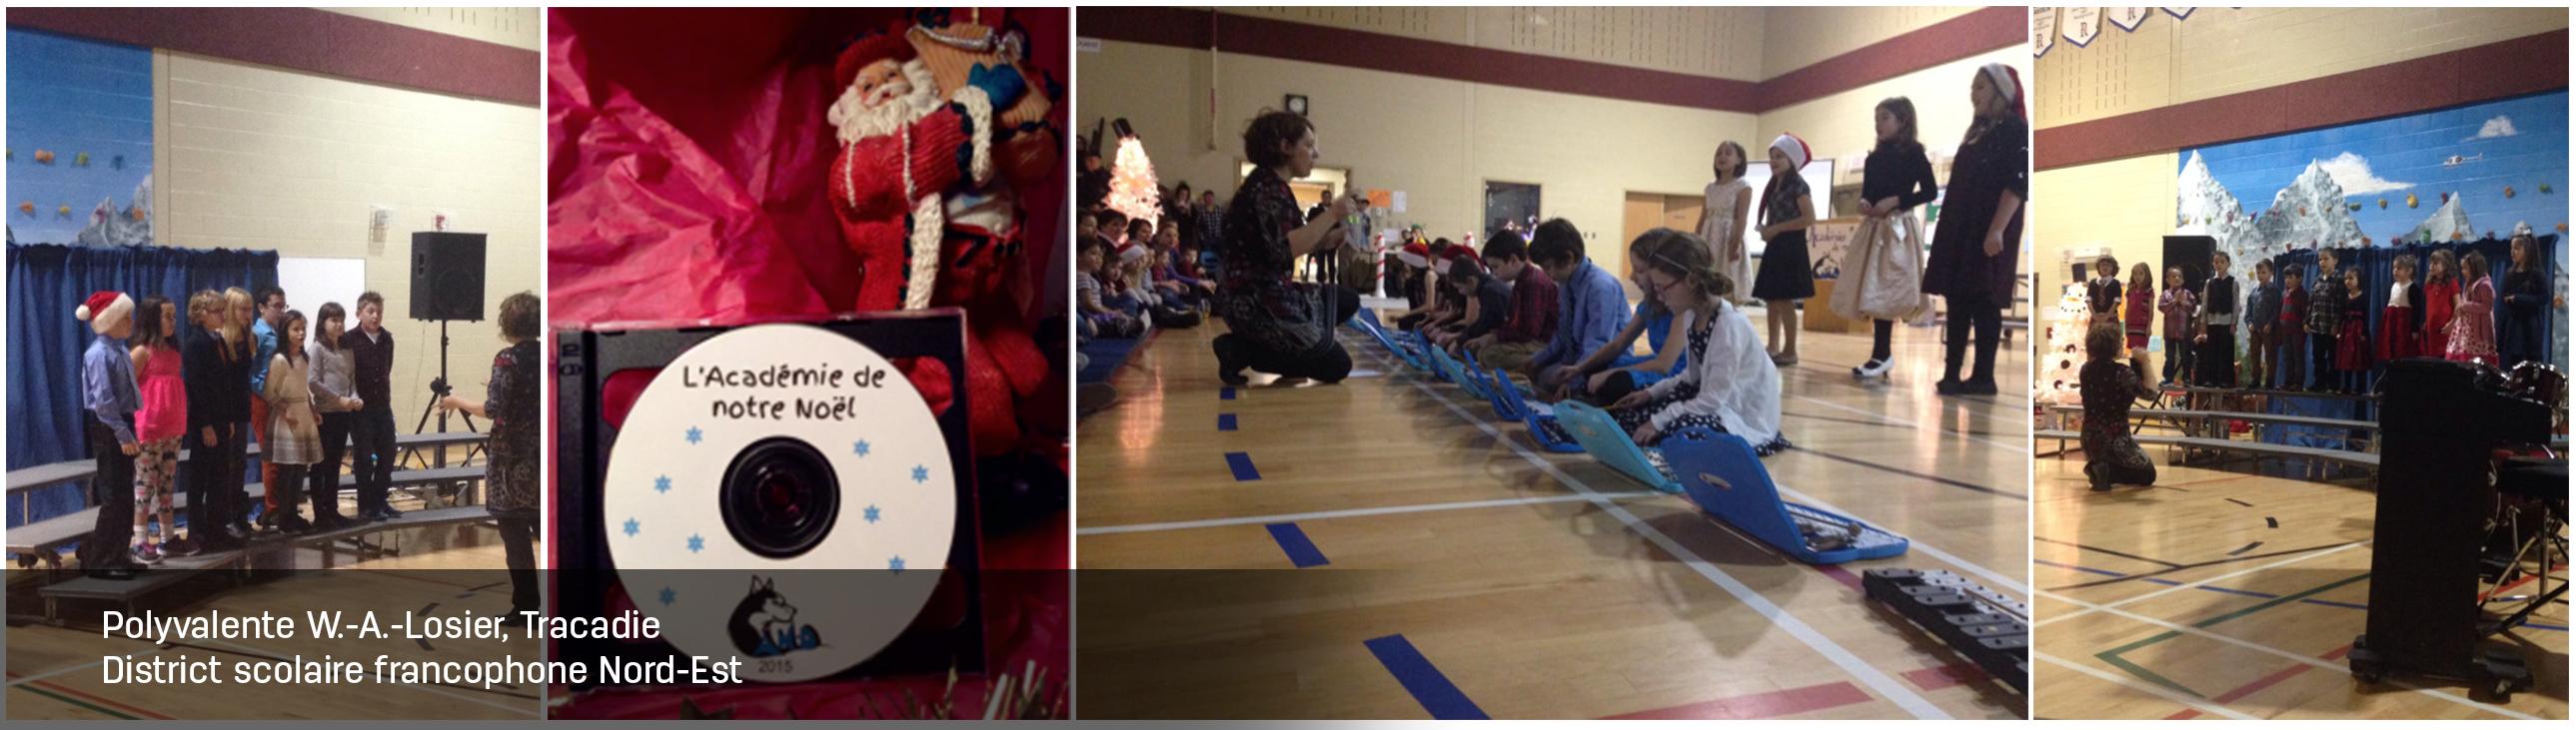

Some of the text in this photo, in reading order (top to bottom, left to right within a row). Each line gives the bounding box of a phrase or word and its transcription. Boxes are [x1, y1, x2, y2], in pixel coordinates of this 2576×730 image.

[2080, 21, 2088, 38] R
[683, 363, 886, 388] L'Académie de
[711, 395, 856, 421] notre Noël
[758, 660, 793, 674] 2015
